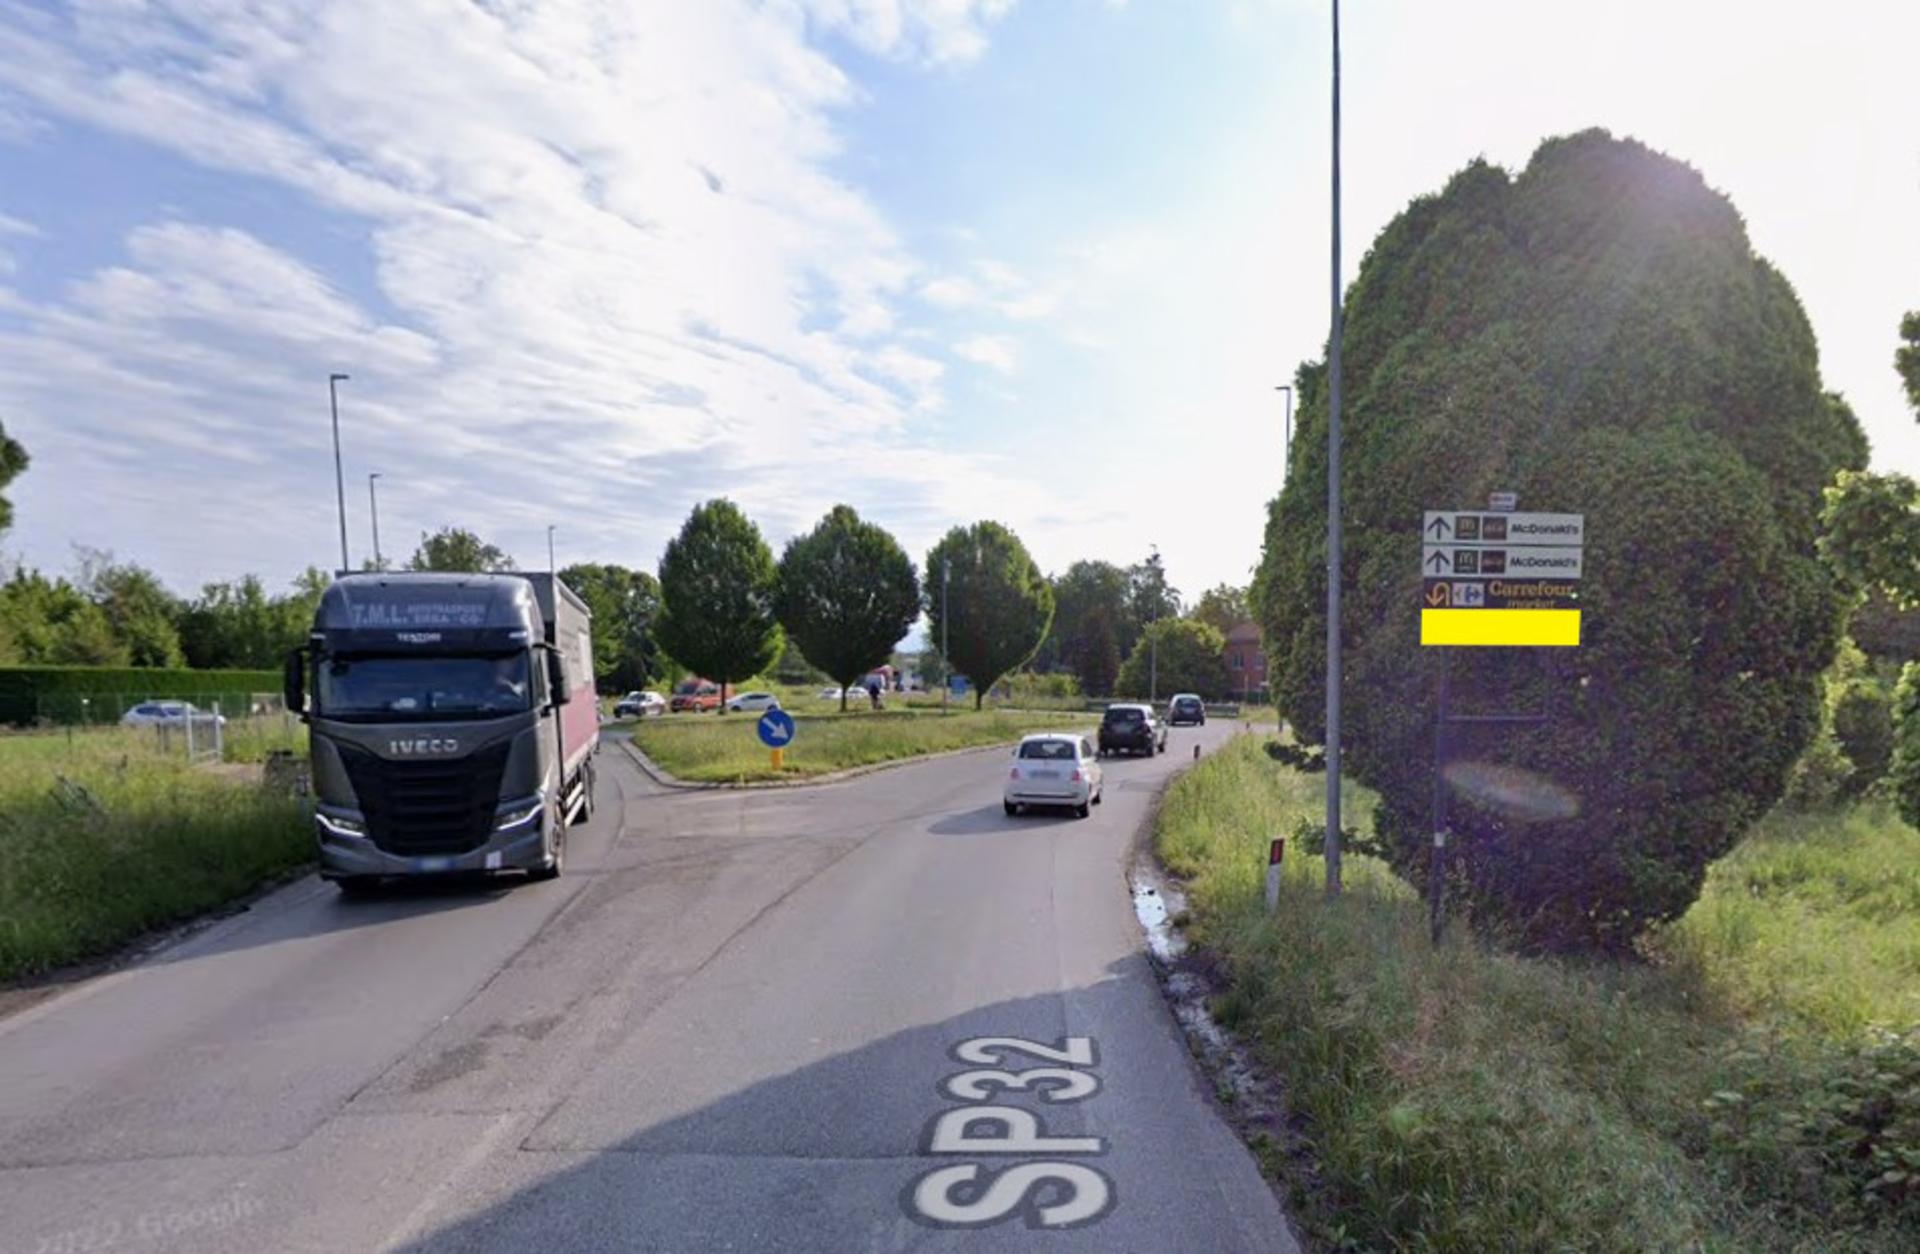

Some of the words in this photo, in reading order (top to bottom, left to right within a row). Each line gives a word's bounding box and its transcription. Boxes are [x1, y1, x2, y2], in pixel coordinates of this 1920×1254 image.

[1511, 523, 1579, 535] McDonald's
[1510, 556, 1578, 568] McDonald's
[1489, 580, 1575, 597] Carrefour
[388, 739, 459, 754] IVECO
